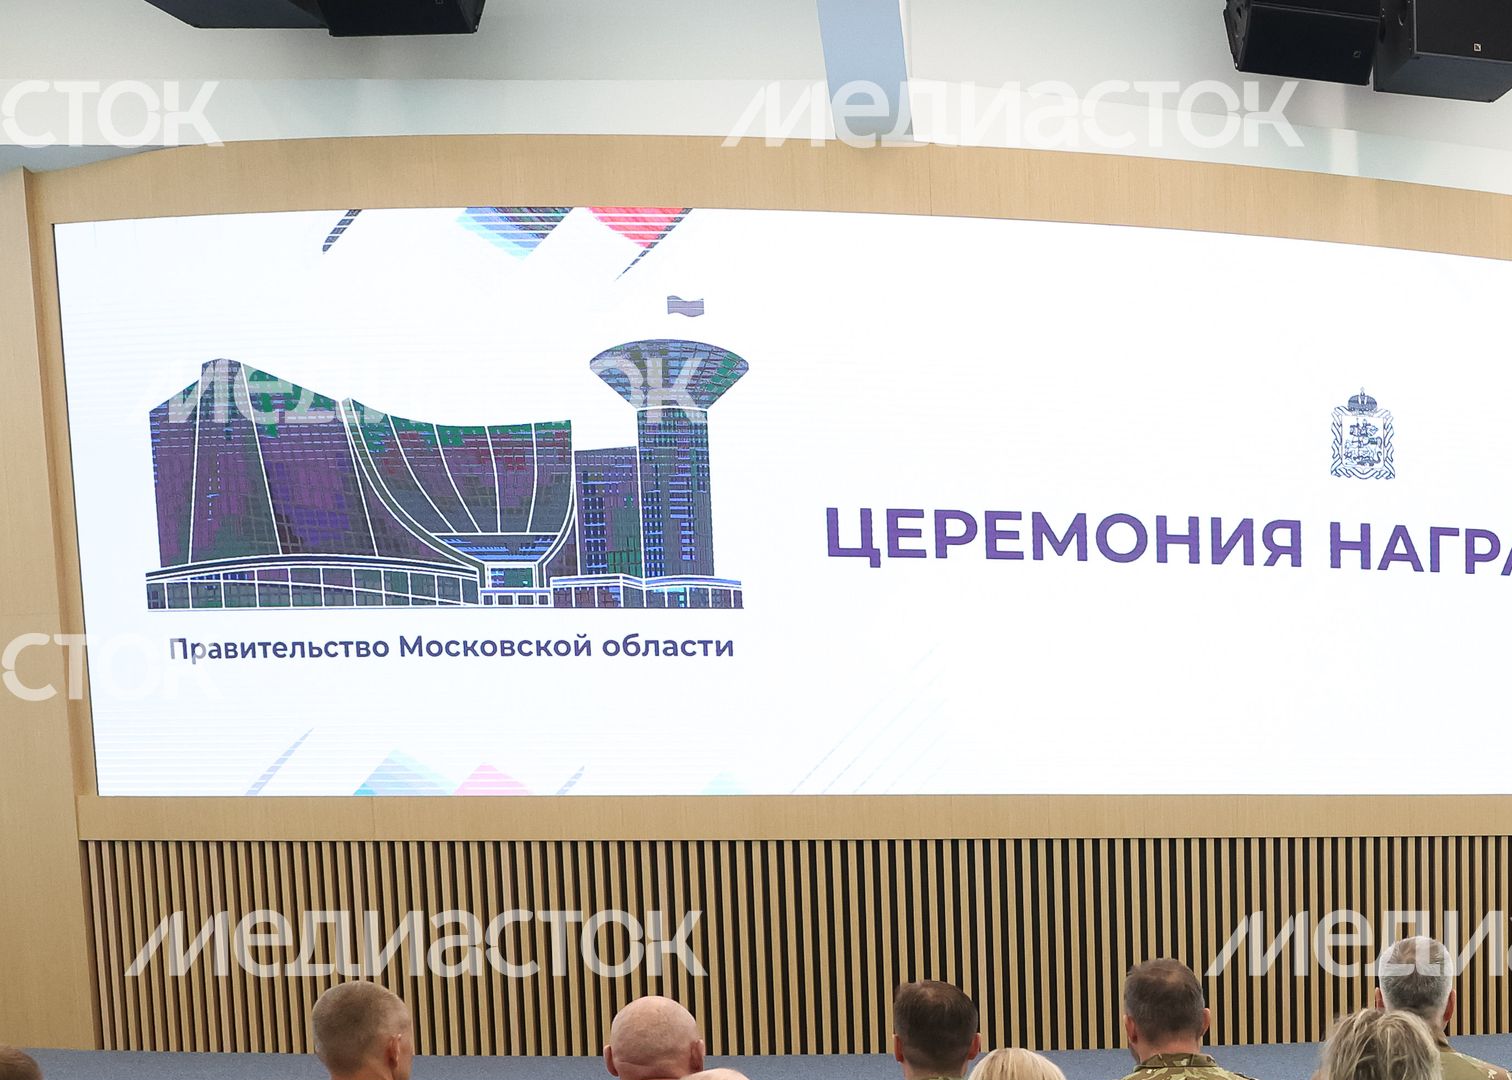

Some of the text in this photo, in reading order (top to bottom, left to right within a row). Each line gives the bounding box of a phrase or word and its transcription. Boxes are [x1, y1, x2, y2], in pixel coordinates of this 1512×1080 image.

[825, 507, 1302, 568] ЦЕРЕМОНИЯ
[169, 632, 734, 664] Правительство Московской области
